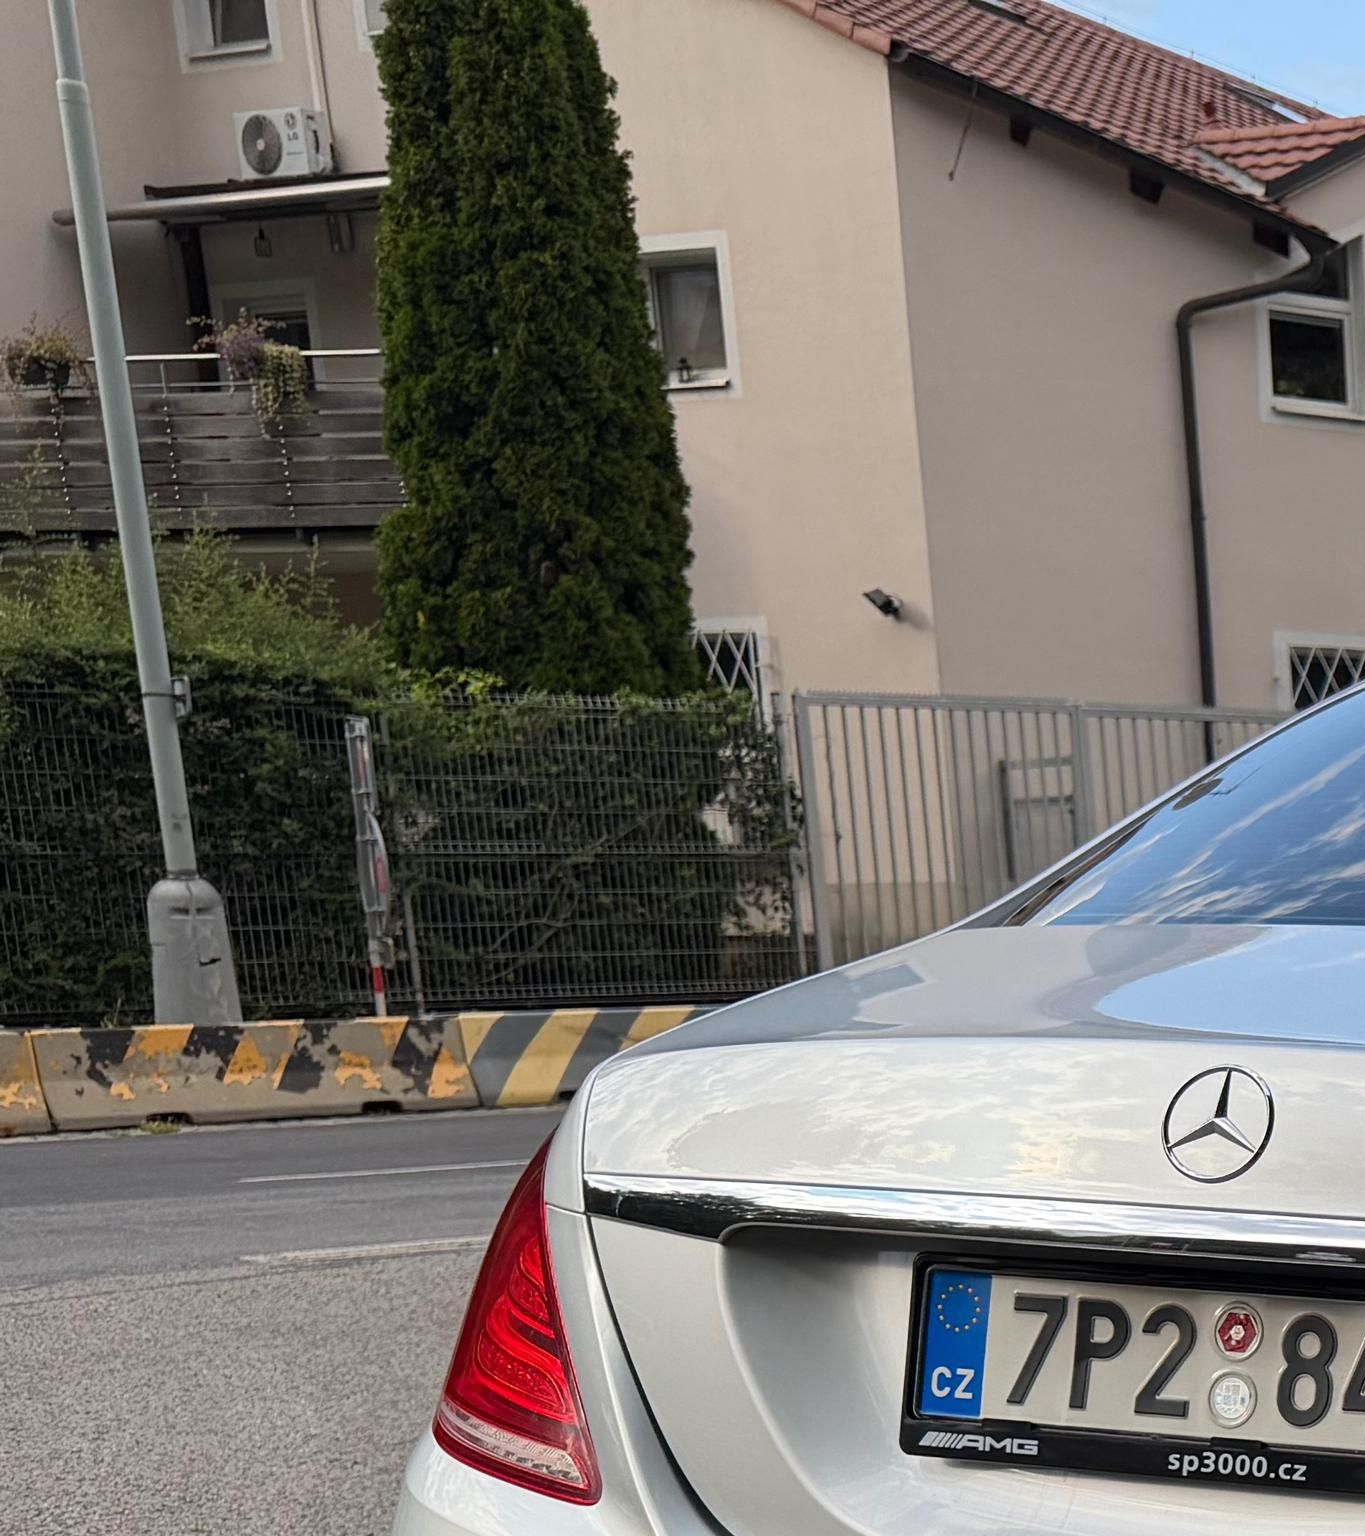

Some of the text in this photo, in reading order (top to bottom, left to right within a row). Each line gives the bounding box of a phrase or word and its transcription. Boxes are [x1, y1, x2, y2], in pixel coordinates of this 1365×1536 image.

[287, 131, 299, 141] LG
[1007, 1291, 1197, 1419] 7P2
[930, 1366, 975, 1400] CZ
[958, 1435, 1039, 1456] AMG
[1167, 1451, 1307, 1482] sp3000.cz
